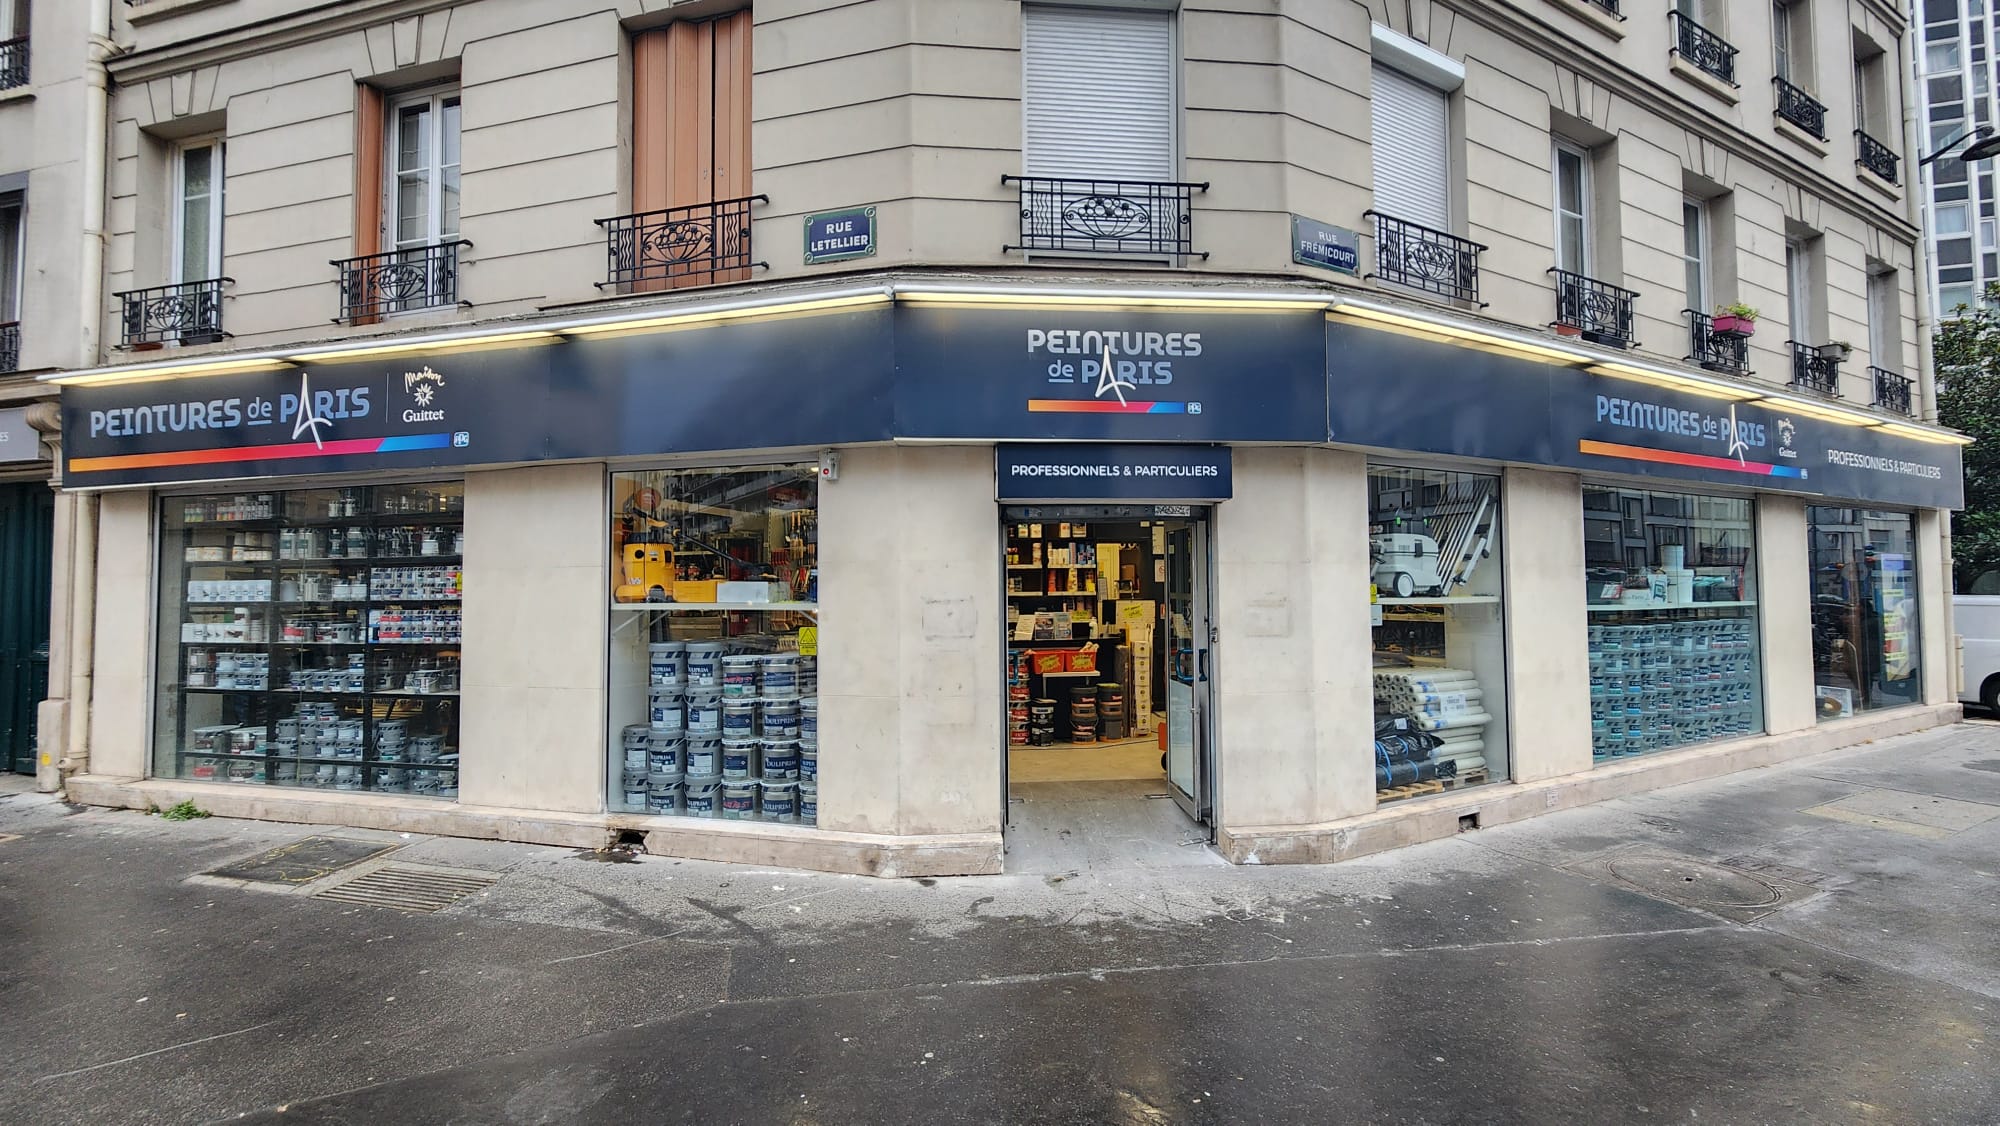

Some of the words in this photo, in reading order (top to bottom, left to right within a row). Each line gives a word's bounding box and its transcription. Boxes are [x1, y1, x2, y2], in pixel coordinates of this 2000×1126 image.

[826, 221, 852, 234] RUE
[1318, 231, 1338, 244] RUE
[811, 235, 868, 251] LETELLIER
[1301, 240, 1354, 264] FRÉMICOURT
[1027, 329, 1202, 357] PEINTURES
[405, 365, 445, 393] Maison
[1048, 360, 1074, 383] de
[1081, 345, 1173, 407] PARIS
[90, 398, 241, 438] PEINTURES
[247, 396, 273, 426] de
[280, 372, 371, 450] PARIS
[402, 409, 444, 423] Guittet
[1596, 394, 1700, 437] PEINTURES
[1702, 416, 1718, 440] de
[1720, 404, 1766, 467] PARIS
[1011, 464, 1120, 477] PROFESSIONNELS
[1123, 465, 1131, 476] &
[1135, 465, 1218, 477] PARTICULIERS
[1828, 449, 1893, 473] PROFESSIONNELS
[1893, 460, 1900, 473] &
[1900, 461, 1941, 479] PARTICULIERS
